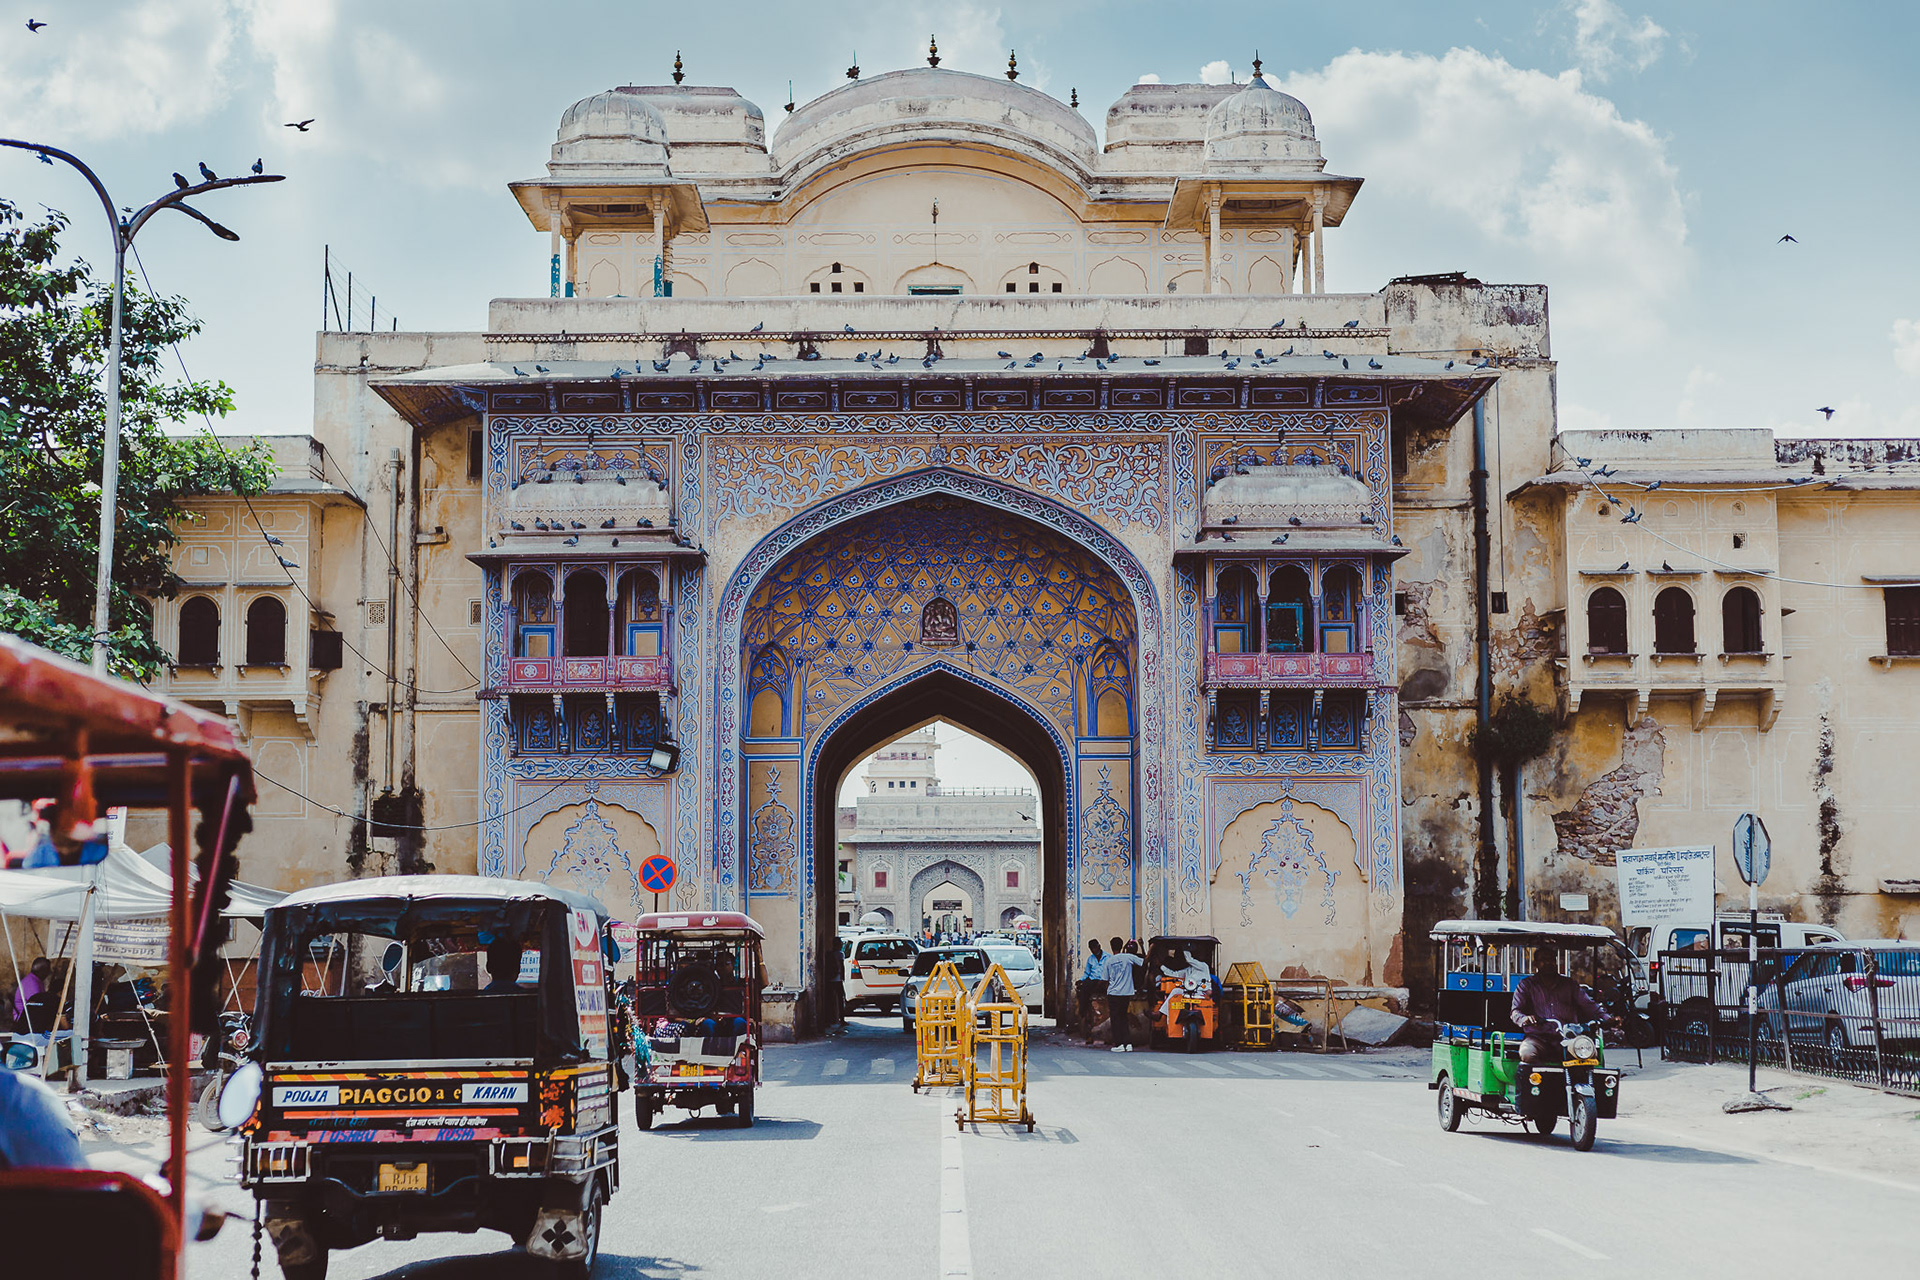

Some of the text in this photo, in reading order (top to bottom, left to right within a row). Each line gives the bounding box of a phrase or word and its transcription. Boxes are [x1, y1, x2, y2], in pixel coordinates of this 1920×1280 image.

[1660, 866, 1684, 874] परिसर
[282, 1090, 328, 1103] POOJA
[339, 1087, 432, 1104] PIAGGIO
[473, 1086, 517, 1099] KARAN
